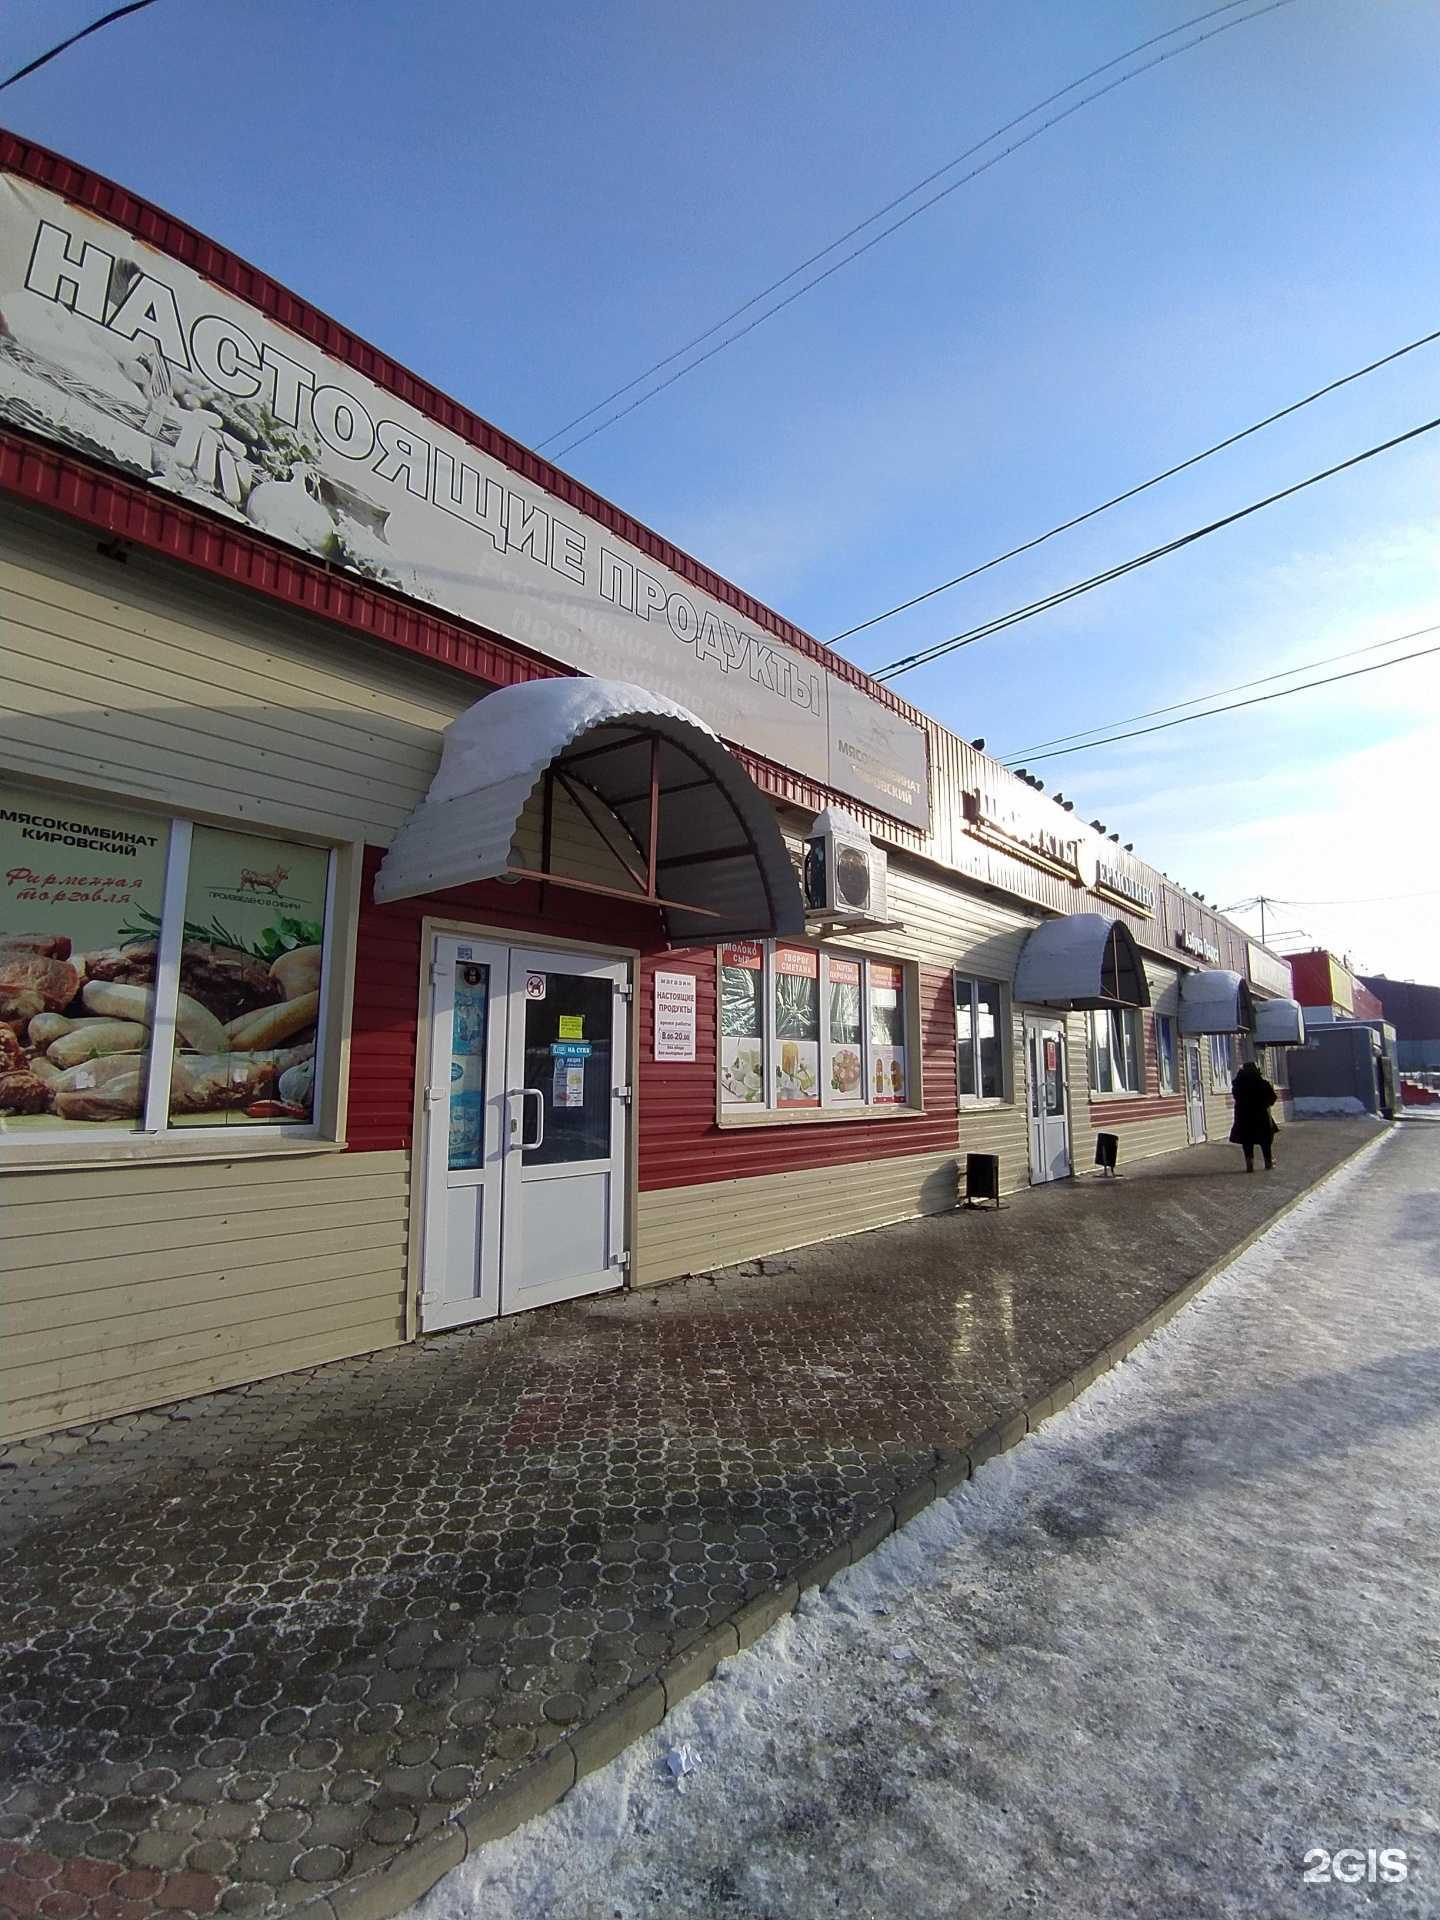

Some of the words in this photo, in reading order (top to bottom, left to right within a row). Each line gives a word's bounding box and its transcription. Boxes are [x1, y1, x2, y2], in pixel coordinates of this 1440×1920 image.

[24, 219, 586, 586] НАСТОЯЩИЕ
[600, 546, 821, 718] ПРОДУКТЫ
[0, 809, 158, 847] МЯСОКОМБИНАТ
[22, 827, 138, 857] КИРОВСКИЙ
[6, 867, 144, 889] Фирменная
[16, 887, 132, 904] торговля
[781, 961, 812, 974] СМЕТАНА
[657, 991, 694, 1002] НАСТОЯЩИЕ
[658, 1003, 693, 1014] ПРОДУКТЫ
